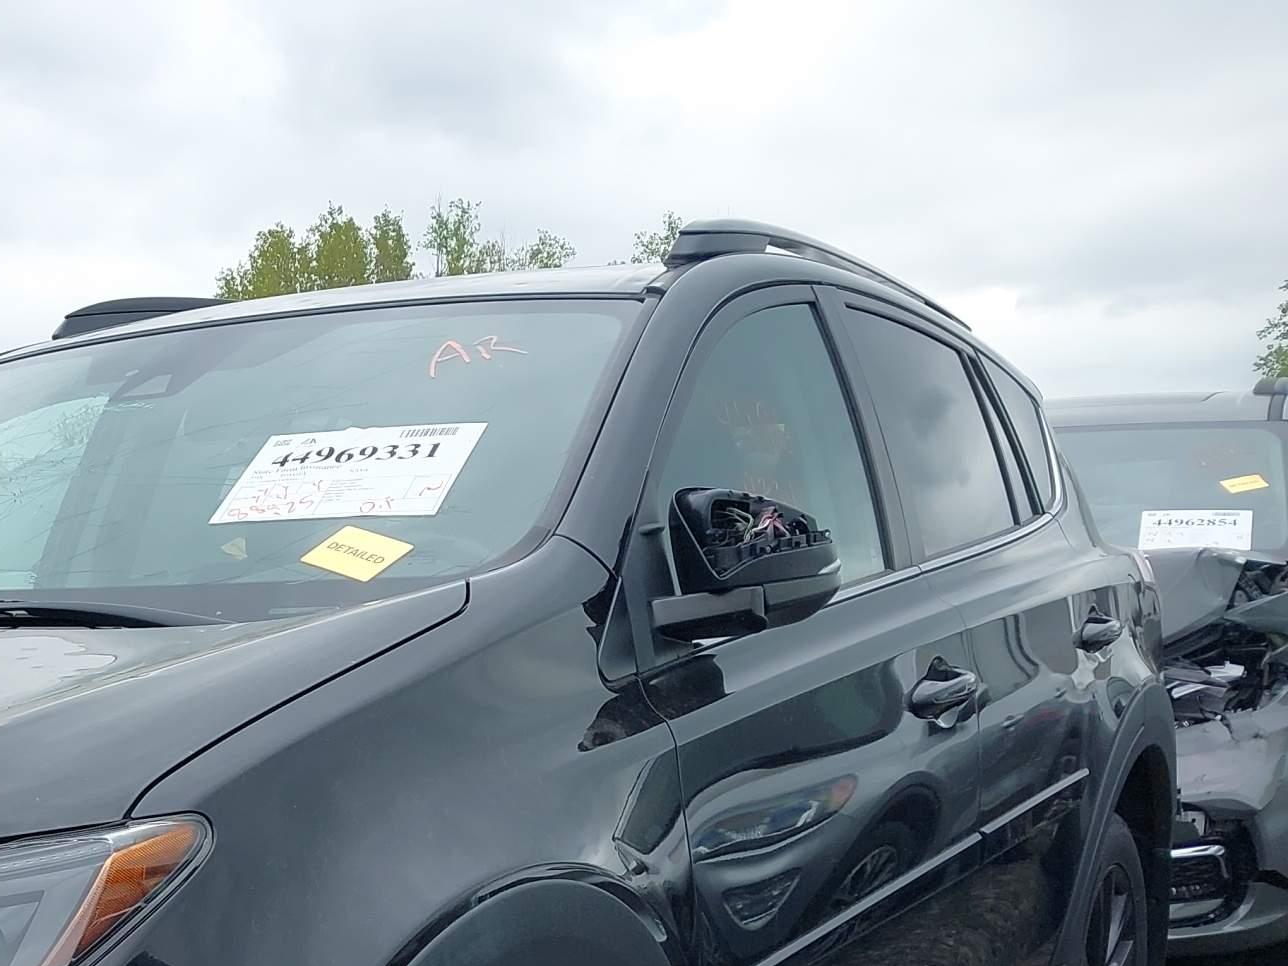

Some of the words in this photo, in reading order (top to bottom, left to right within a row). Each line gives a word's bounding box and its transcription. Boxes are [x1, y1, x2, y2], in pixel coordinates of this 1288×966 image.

[272, 442, 441, 467] 44969331
[1152, 518, 1237, 526] 44962854
[326, 541, 385, 564] DETAILED
